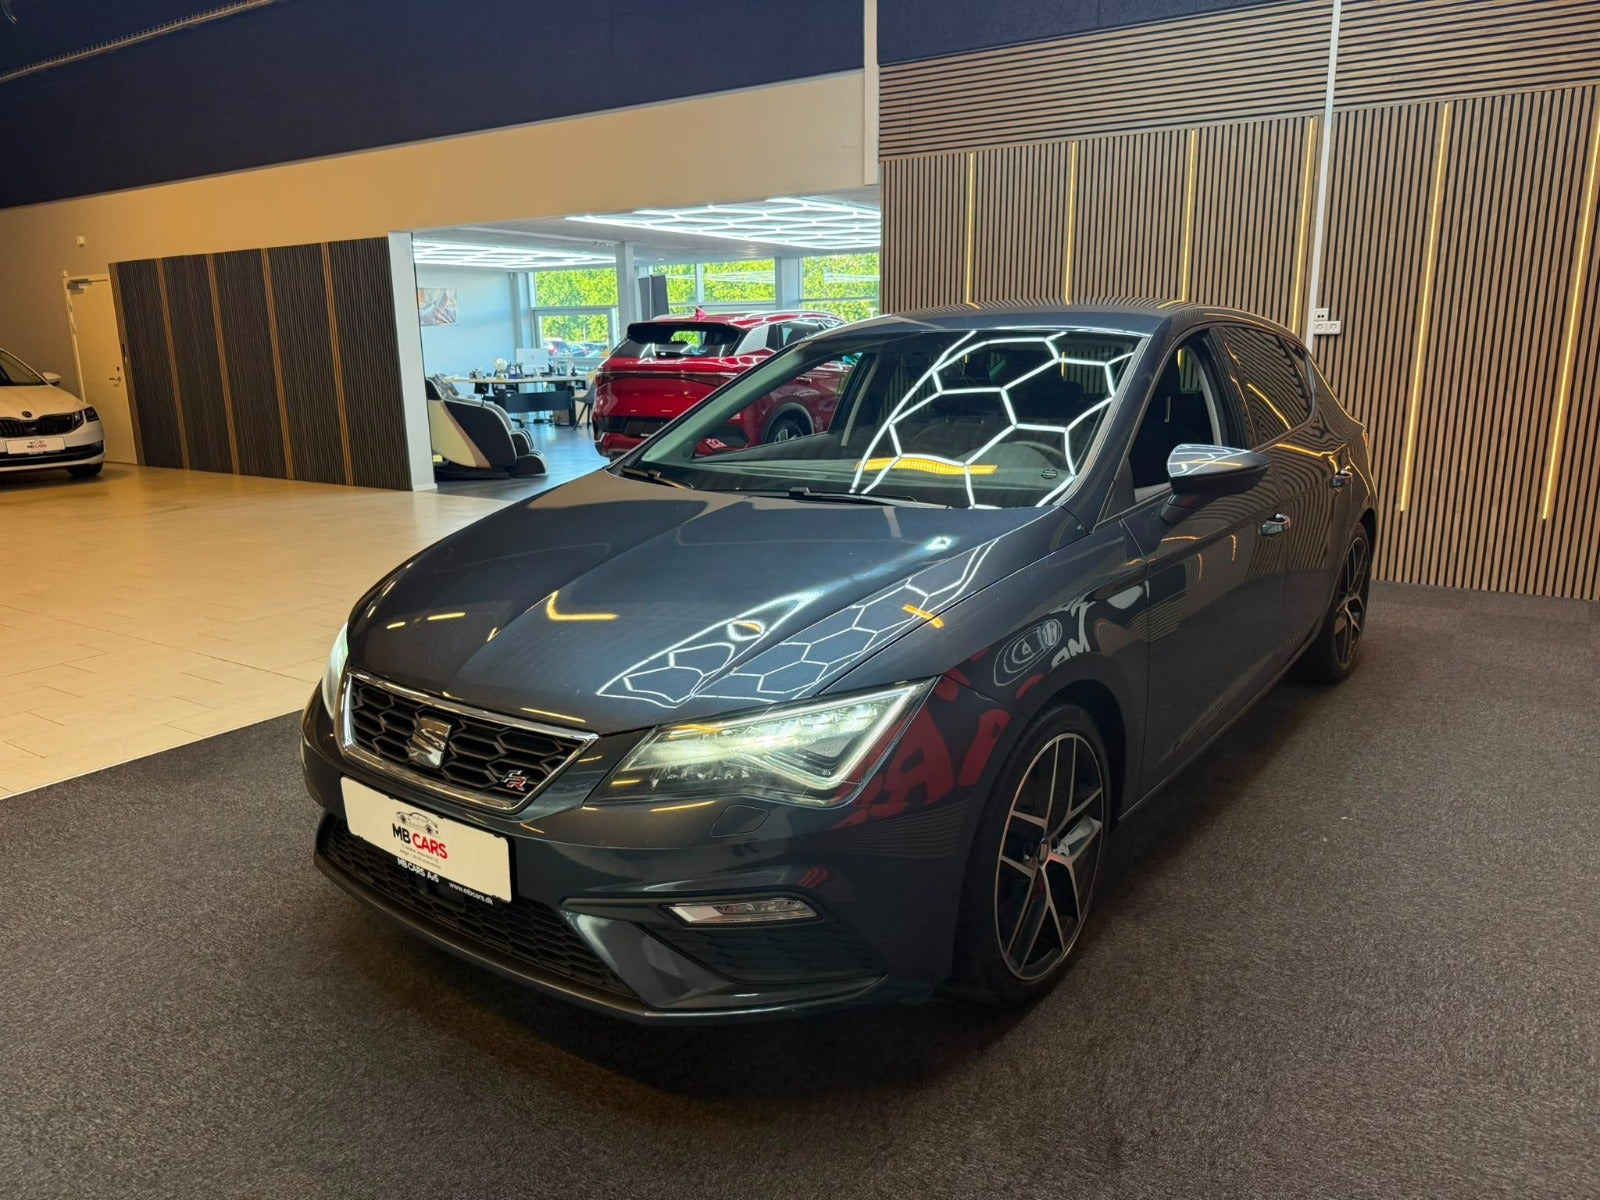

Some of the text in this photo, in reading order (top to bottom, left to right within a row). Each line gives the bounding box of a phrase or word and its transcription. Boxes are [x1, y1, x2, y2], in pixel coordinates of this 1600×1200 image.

[502, 769, 526, 791] FR
[391, 823, 411, 844] MB
[412, 833, 448, 860] CARS
